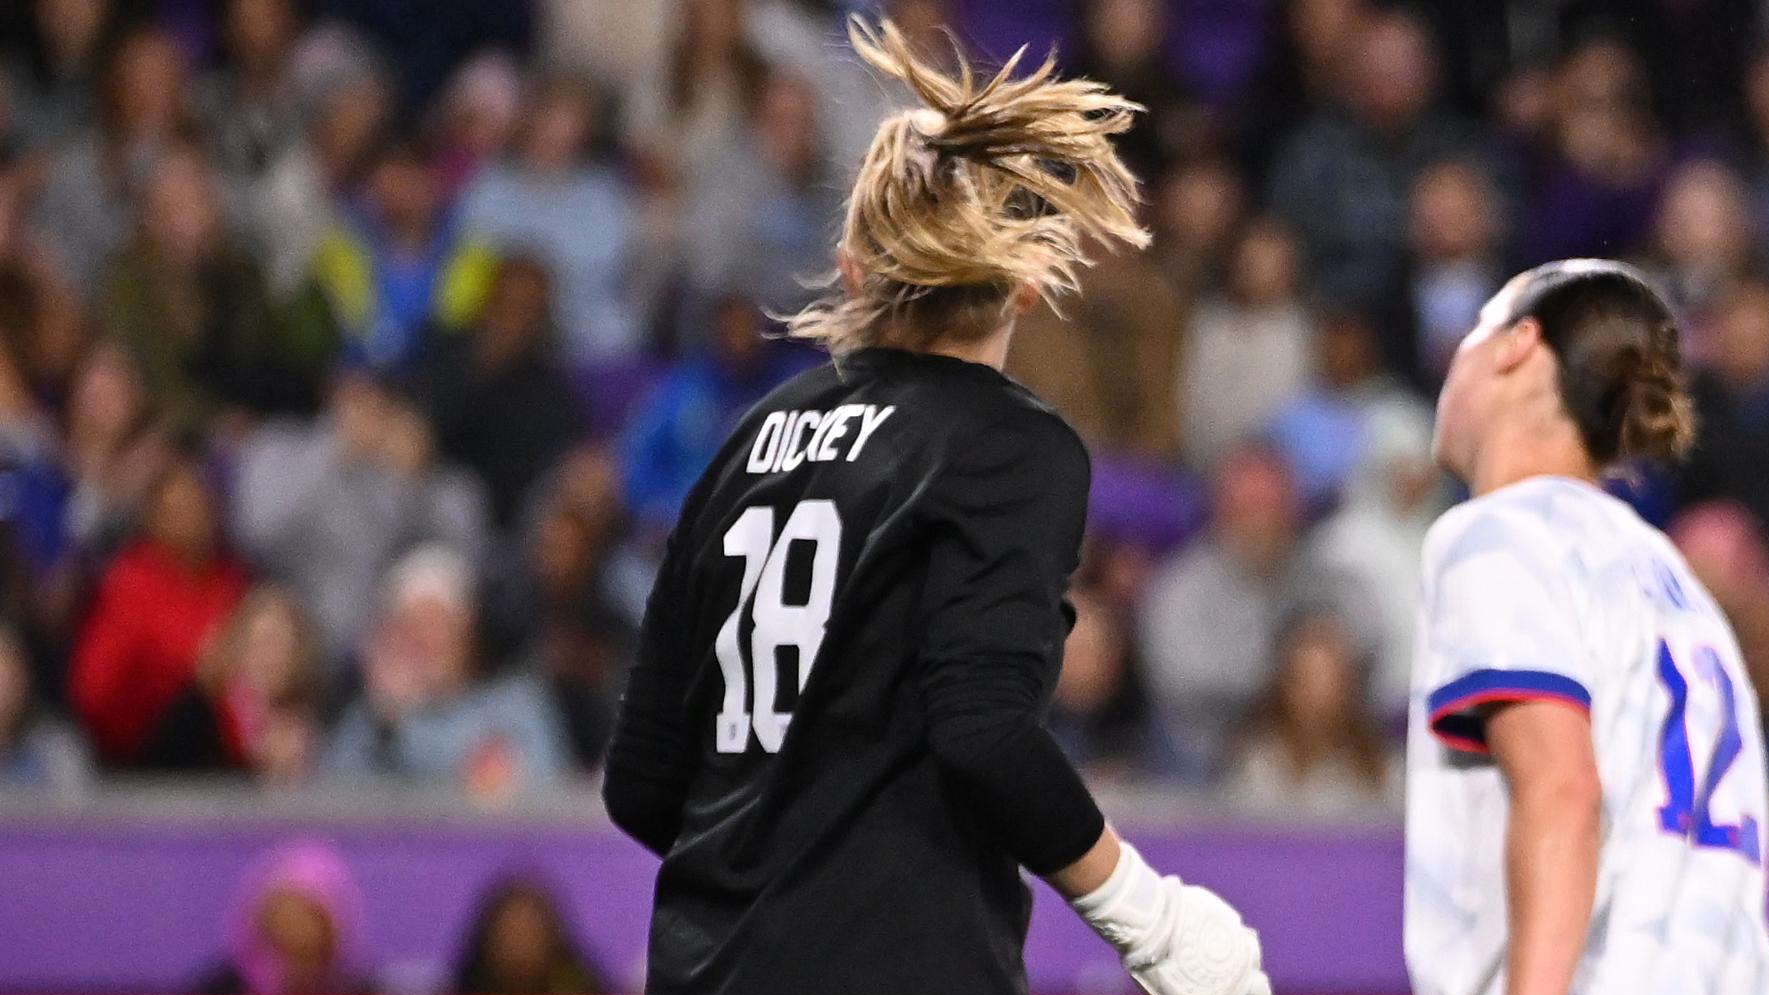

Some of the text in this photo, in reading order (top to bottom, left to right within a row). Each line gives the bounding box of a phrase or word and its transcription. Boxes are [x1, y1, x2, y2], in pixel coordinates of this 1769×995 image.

[746, 403, 896, 474] DICKEY
[715, 499, 842, 753] 18
[1655, 636, 1762, 864] 12
